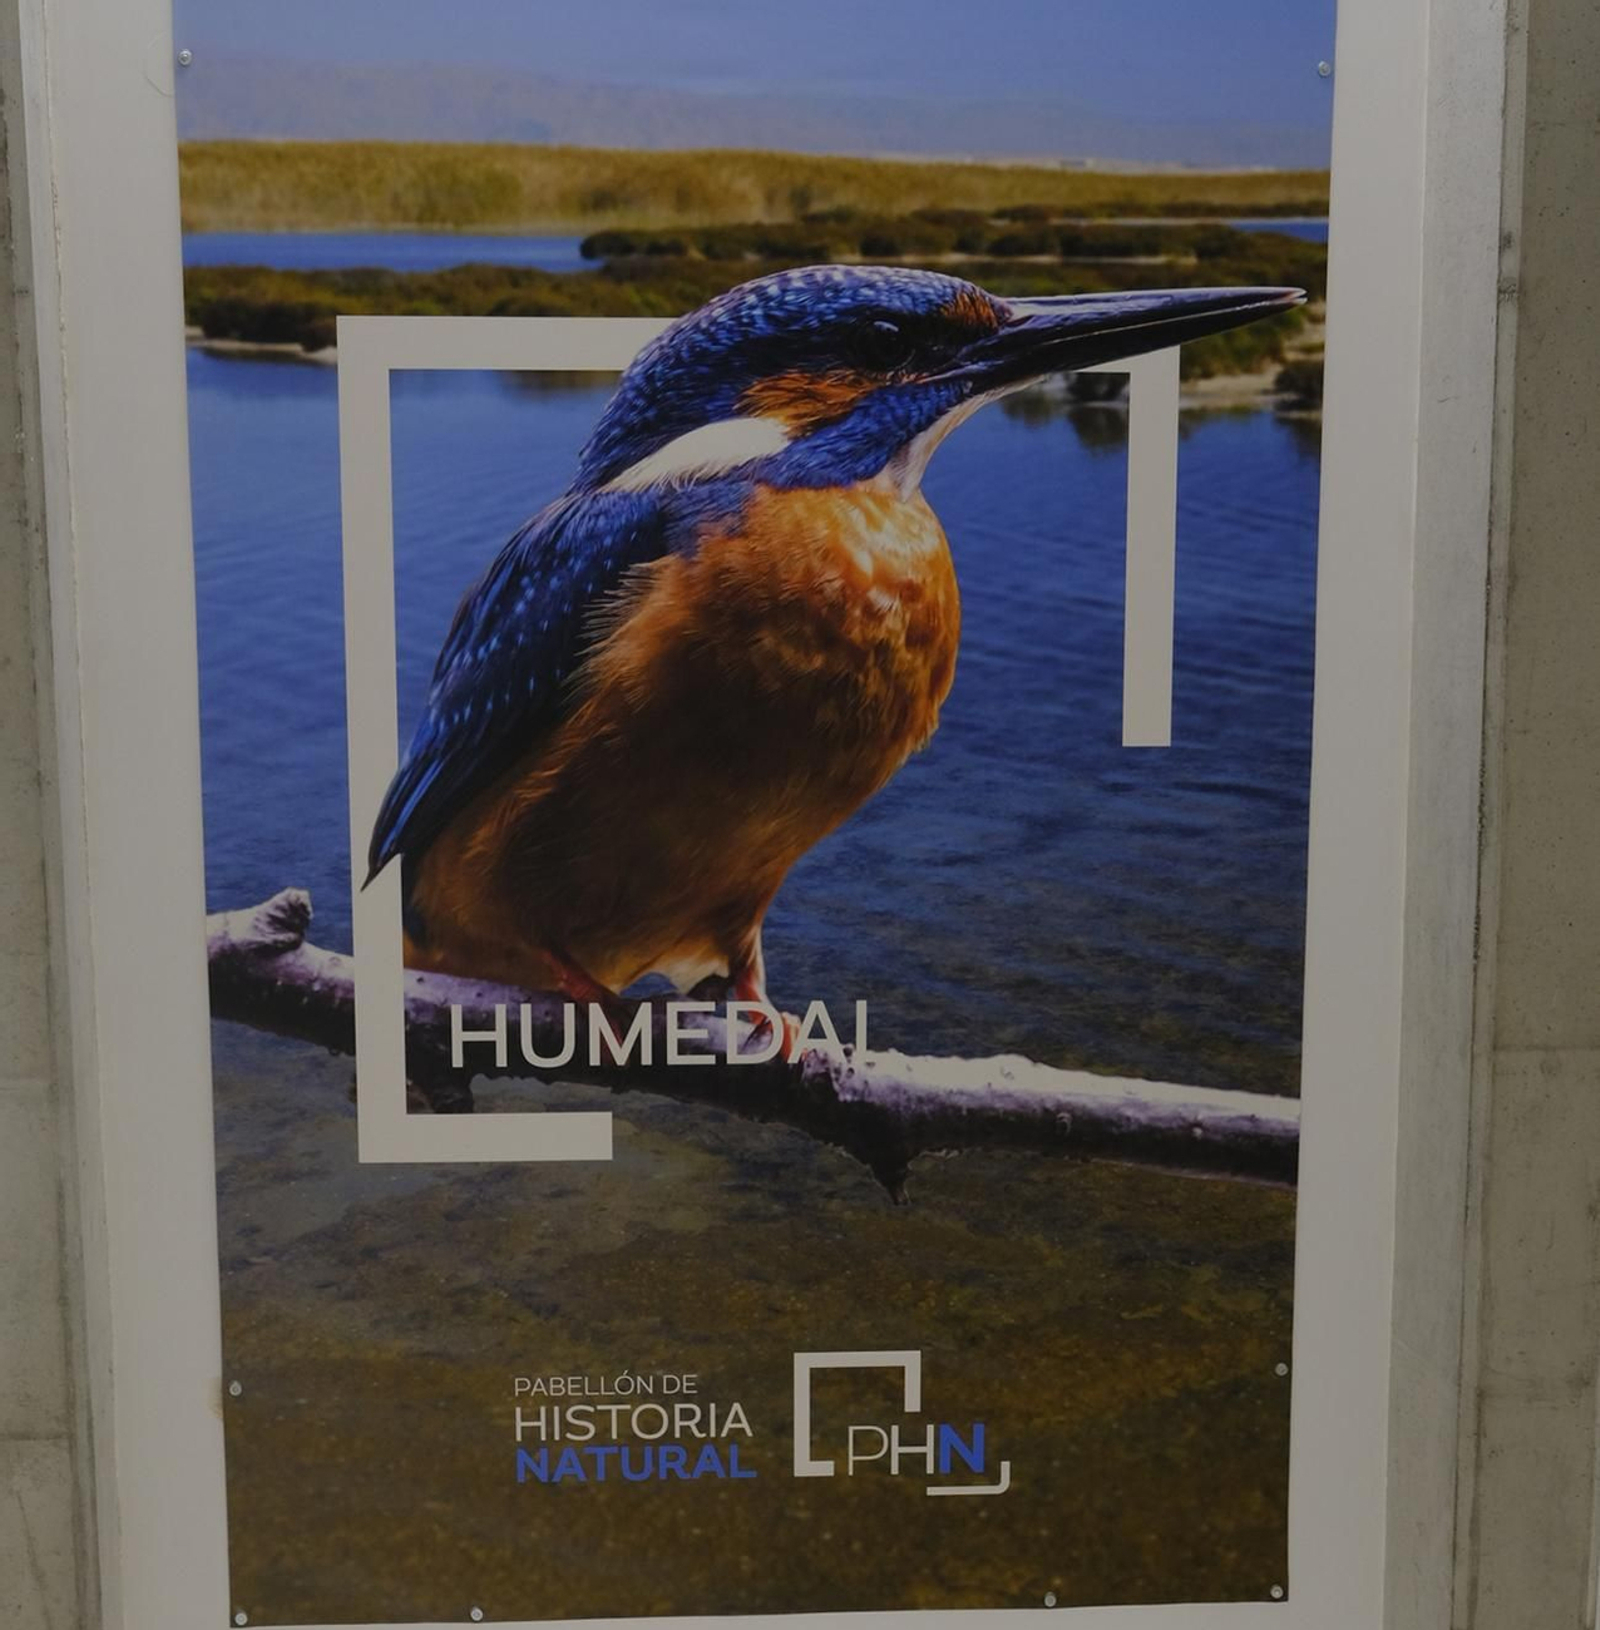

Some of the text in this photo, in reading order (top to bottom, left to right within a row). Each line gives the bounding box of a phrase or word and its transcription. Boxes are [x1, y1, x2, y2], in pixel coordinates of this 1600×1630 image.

[514, 1370, 699, 1397] PABELLÓN DE
[514, 1402, 753, 1442] HISTORIA
[516, 1443, 758, 1483] NATURAL
[848, 1423, 985, 1476] PHN
